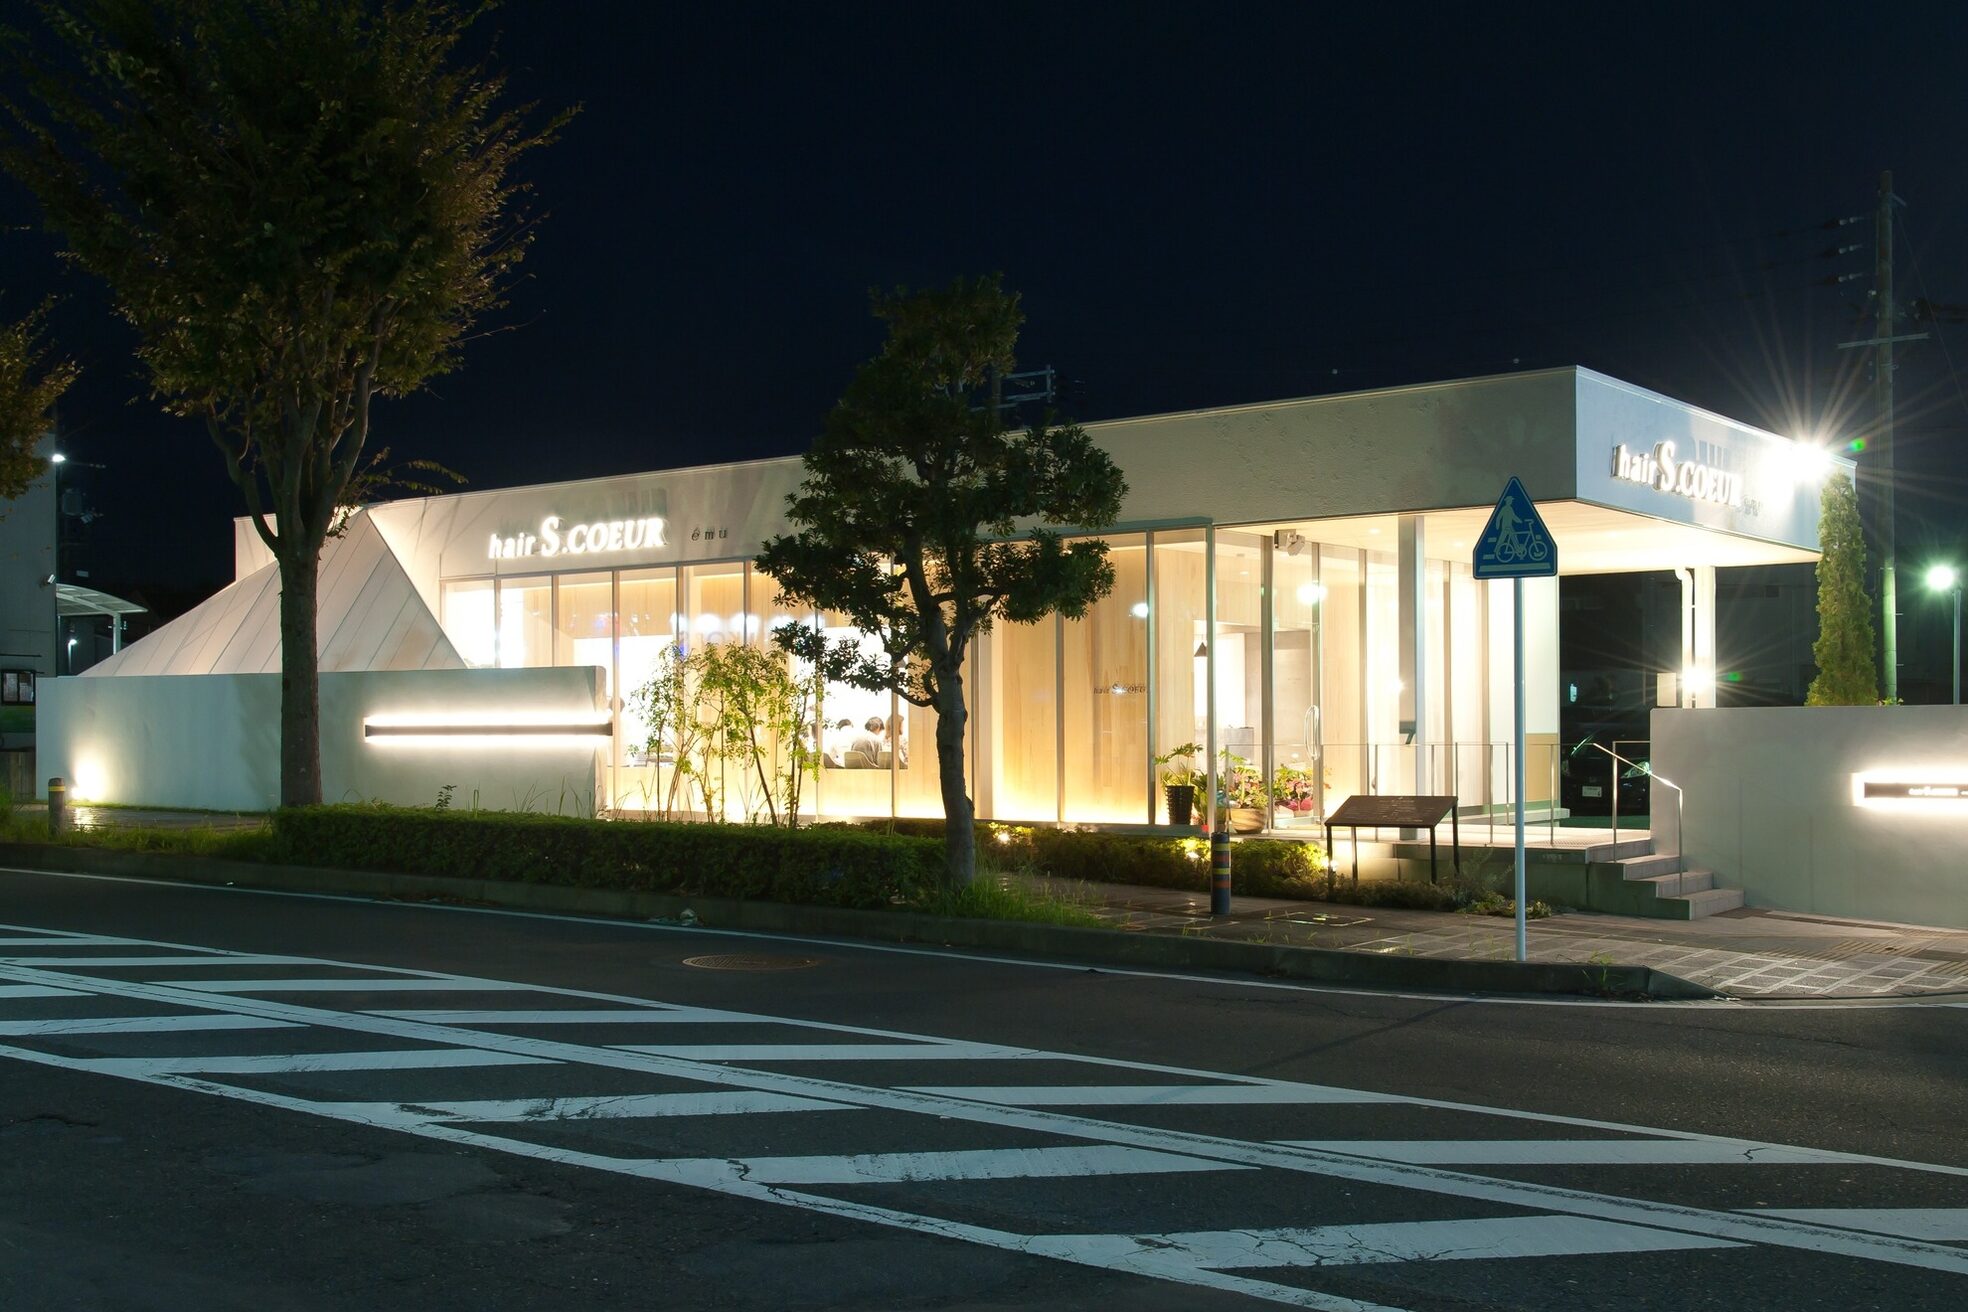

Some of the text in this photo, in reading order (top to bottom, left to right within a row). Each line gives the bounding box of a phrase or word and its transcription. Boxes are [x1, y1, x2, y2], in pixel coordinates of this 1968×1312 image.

[1612, 443, 1657, 485] hair
[488, 516, 668, 559] hair S.COEUR
